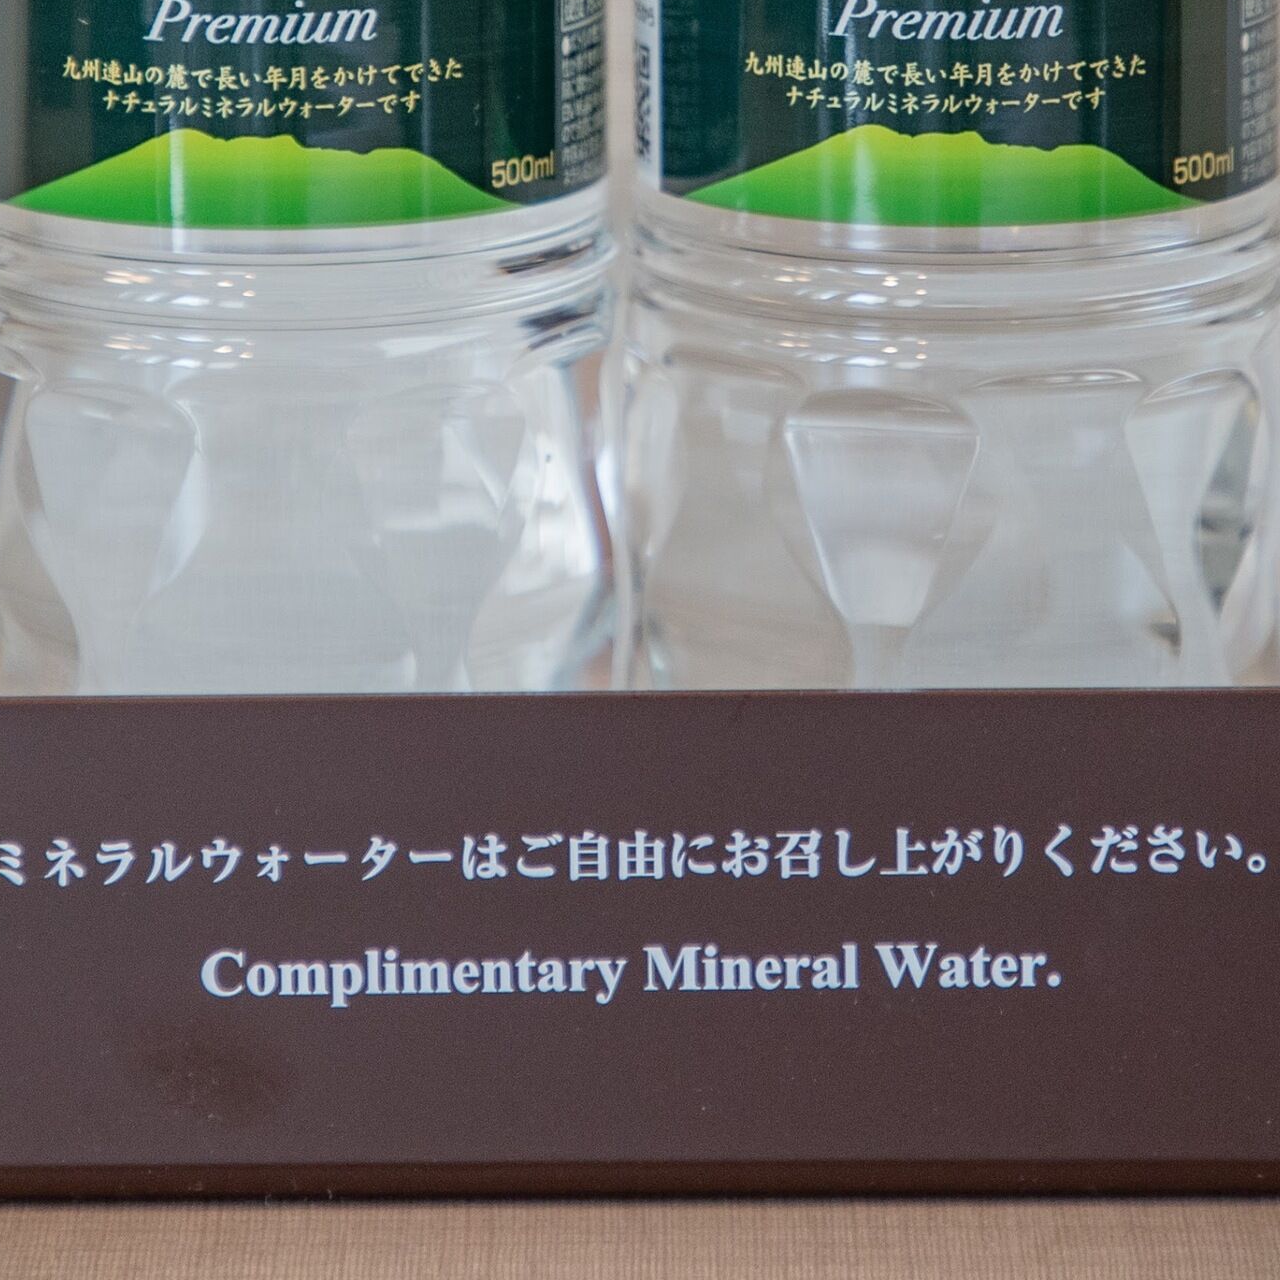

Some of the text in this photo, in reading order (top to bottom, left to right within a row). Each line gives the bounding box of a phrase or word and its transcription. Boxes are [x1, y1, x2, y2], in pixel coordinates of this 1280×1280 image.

[62, 55, 463, 90] 九州連山の麓で長い年月をかけてできた
[744, 51, 1147, 87] 九州連山の麓で長い年月をかけてできた
[102, 89, 421, 118] ナチュラルミネラルウォーターです
[785, 85, 1106, 115] ナチュラルミネラルウォーターです
[491, 150, 554, 188] 500ml
[1173, 146, 1234, 185] 500ml
[199, 941, 1063, 1009] Complimentary Mineral Water.
